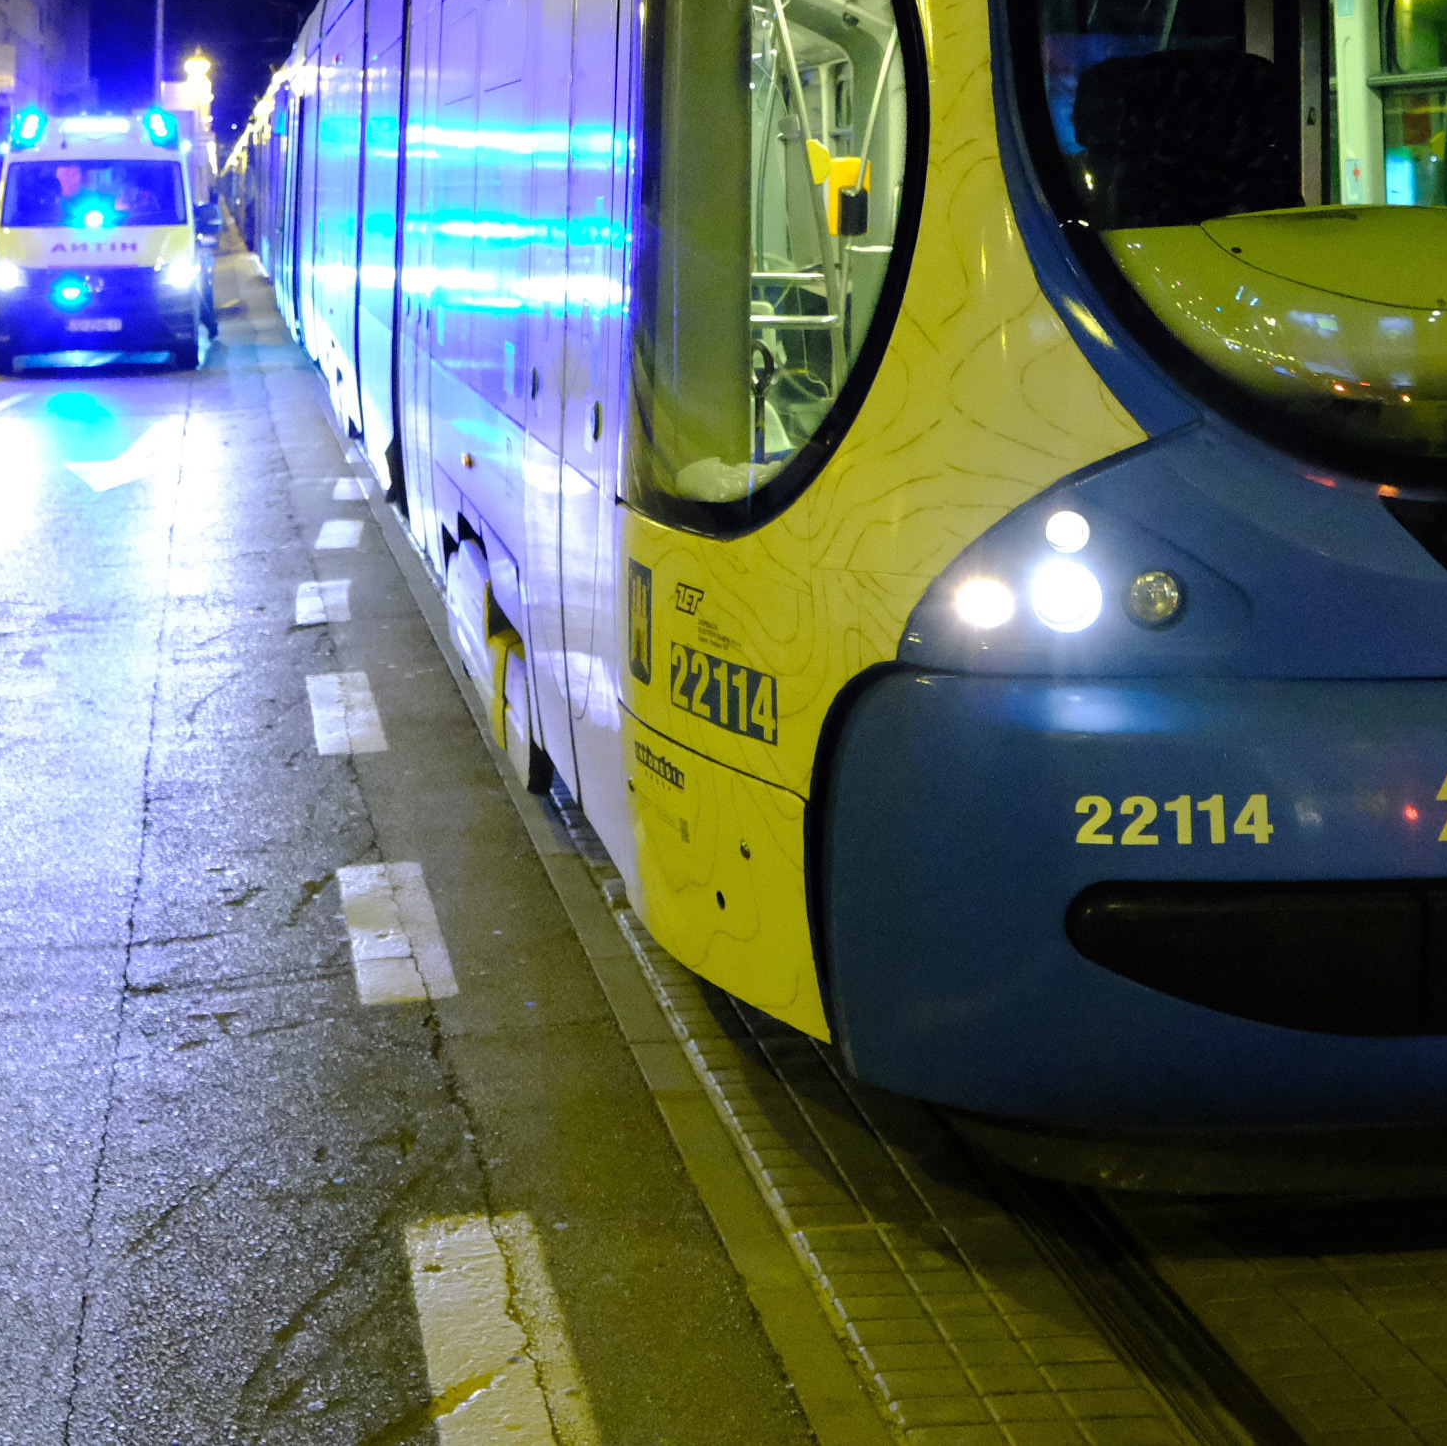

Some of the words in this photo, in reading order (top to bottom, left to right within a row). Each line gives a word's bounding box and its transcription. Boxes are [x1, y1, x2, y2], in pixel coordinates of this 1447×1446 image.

[676, 582, 704, 615] ZET
[671, 644, 777, 743] 22114
[1074, 793, 1274, 845] 22114
